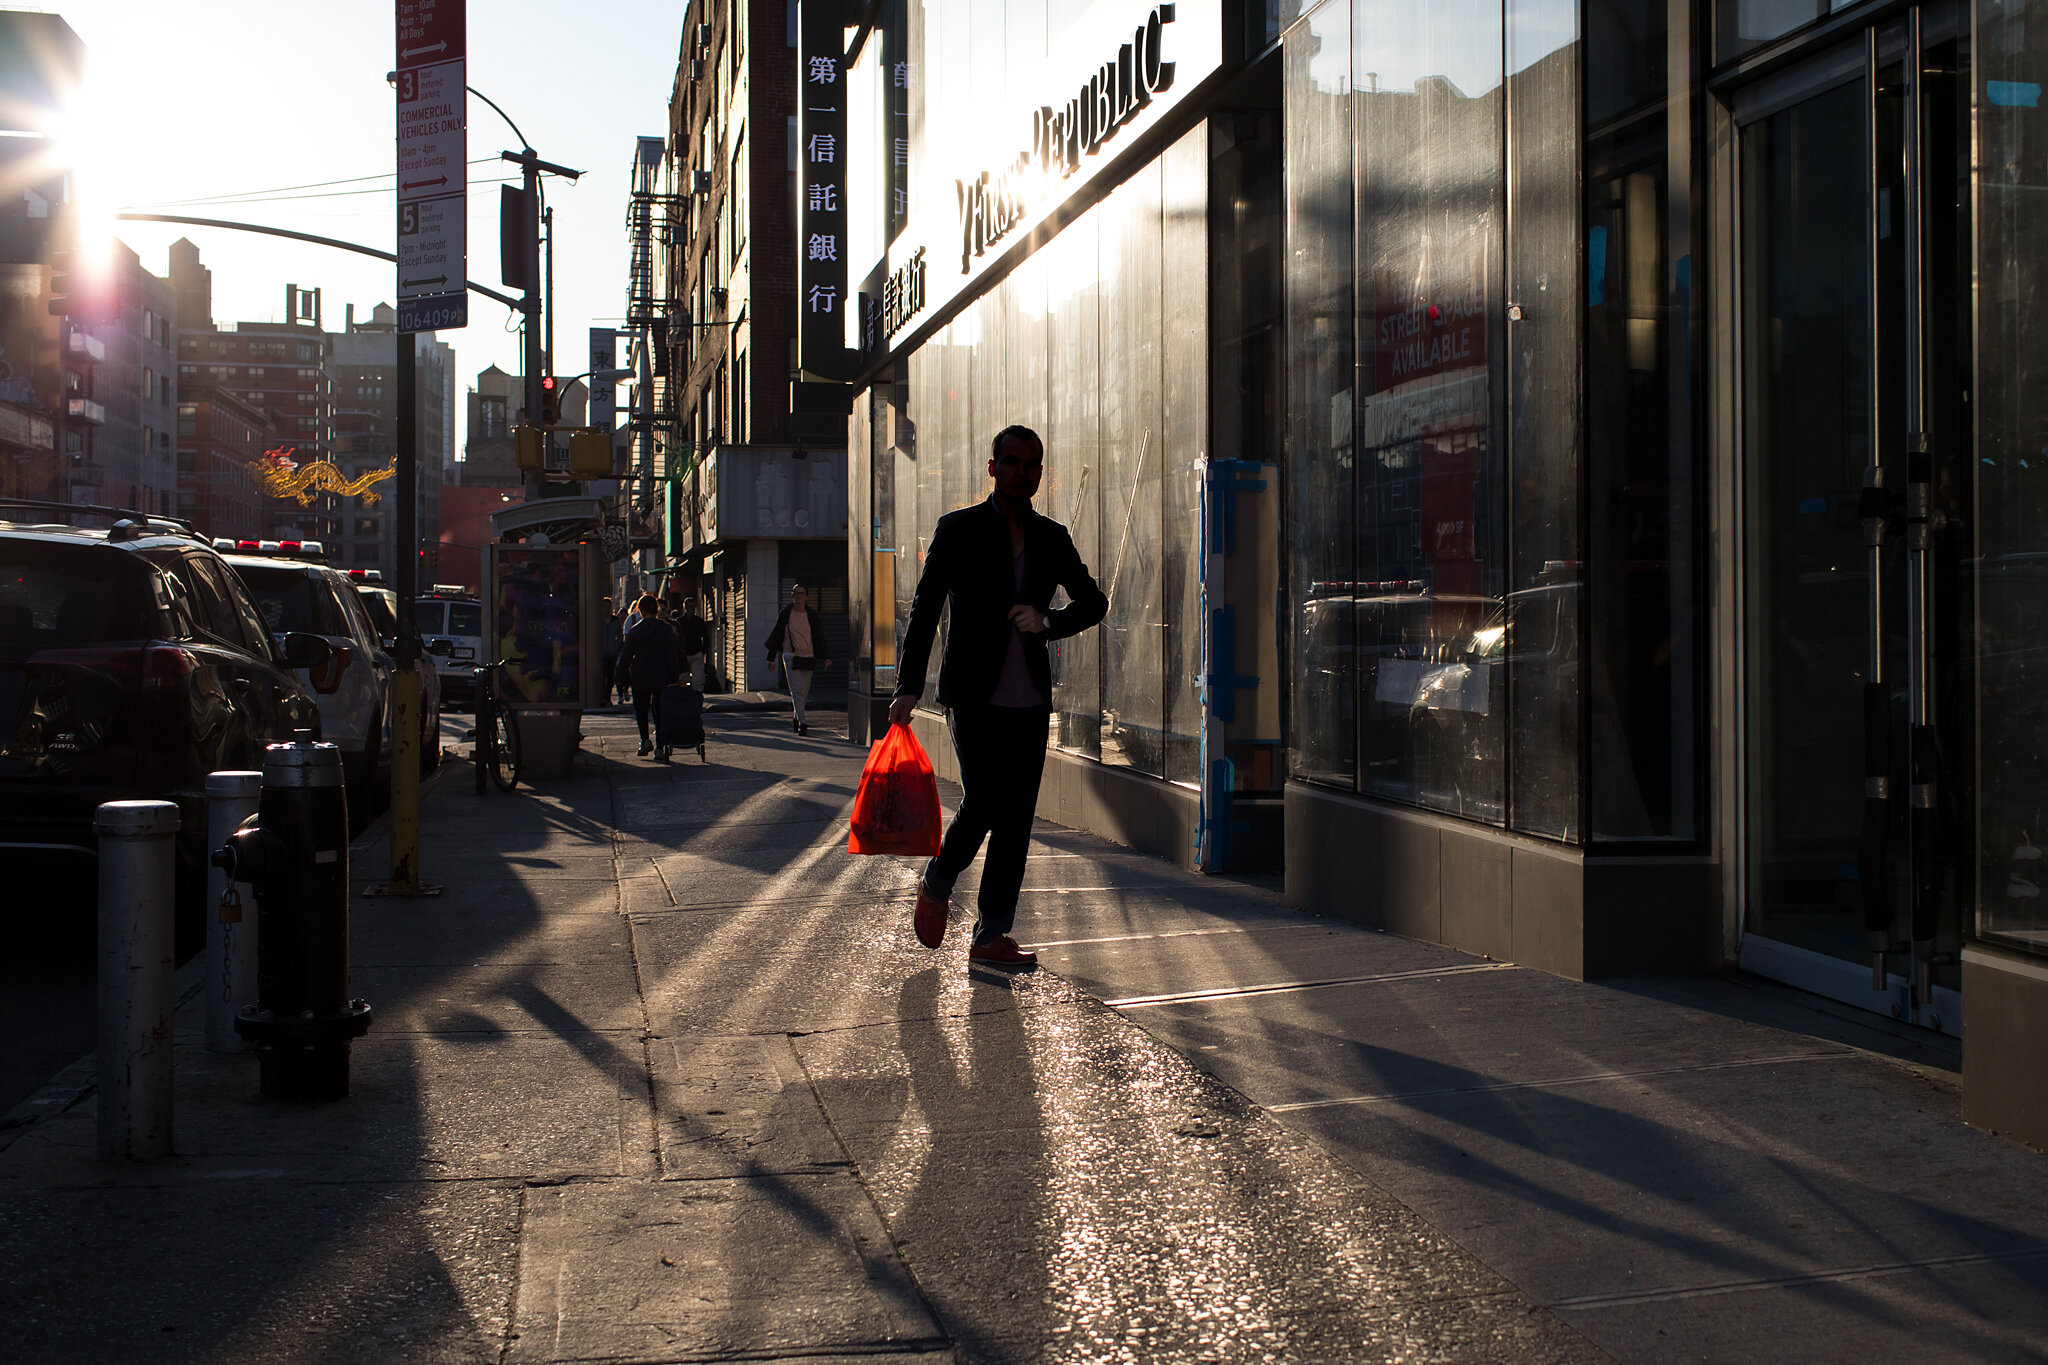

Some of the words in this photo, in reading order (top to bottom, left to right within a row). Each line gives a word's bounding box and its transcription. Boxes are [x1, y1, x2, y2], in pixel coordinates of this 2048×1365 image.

[400, 5, 414, 15] 7am
[400, 16, 414, 29] 4pm
[419, 13, 432, 25] 7pm
[400, 29, 408, 40] All
[410, 28, 424, 40] Days
[420, 71, 432, 80] hour
[420, 77, 443, 90] metered
[402, 72, 414, 99] 3
[1031, 3, 1176, 183] REPUBLIC
[420, 90, 440, 101] parking
[400, 104, 453, 124] COMMERCIAL
[400, 122, 439, 140] VEHICLES
[441, 117, 463, 133] ONLY
[401, 147, 417, 158] 10am
[423, 144, 437, 156] 4pm
[400, 159, 422, 171] Except
[423, 154, 447, 168] Sunday
[808, 56, 837, 313] 第一信託銀行
[402, 205, 414, 233] 5
[420, 213, 444, 223] metered
[420, 224, 441, 234] parking
[401, 243, 414, 256] 7pm
[420, 239, 446, 252] Midnight
[400, 255, 422, 267] Except
[423, 252, 447, 266] Sunday
[400, 308, 450, 330] 106409
[1380, 301, 1431, 345] STREET
[1432, 285, 1485, 328] SPACE
[1391, 327, 1470, 379] AVAILABLE
